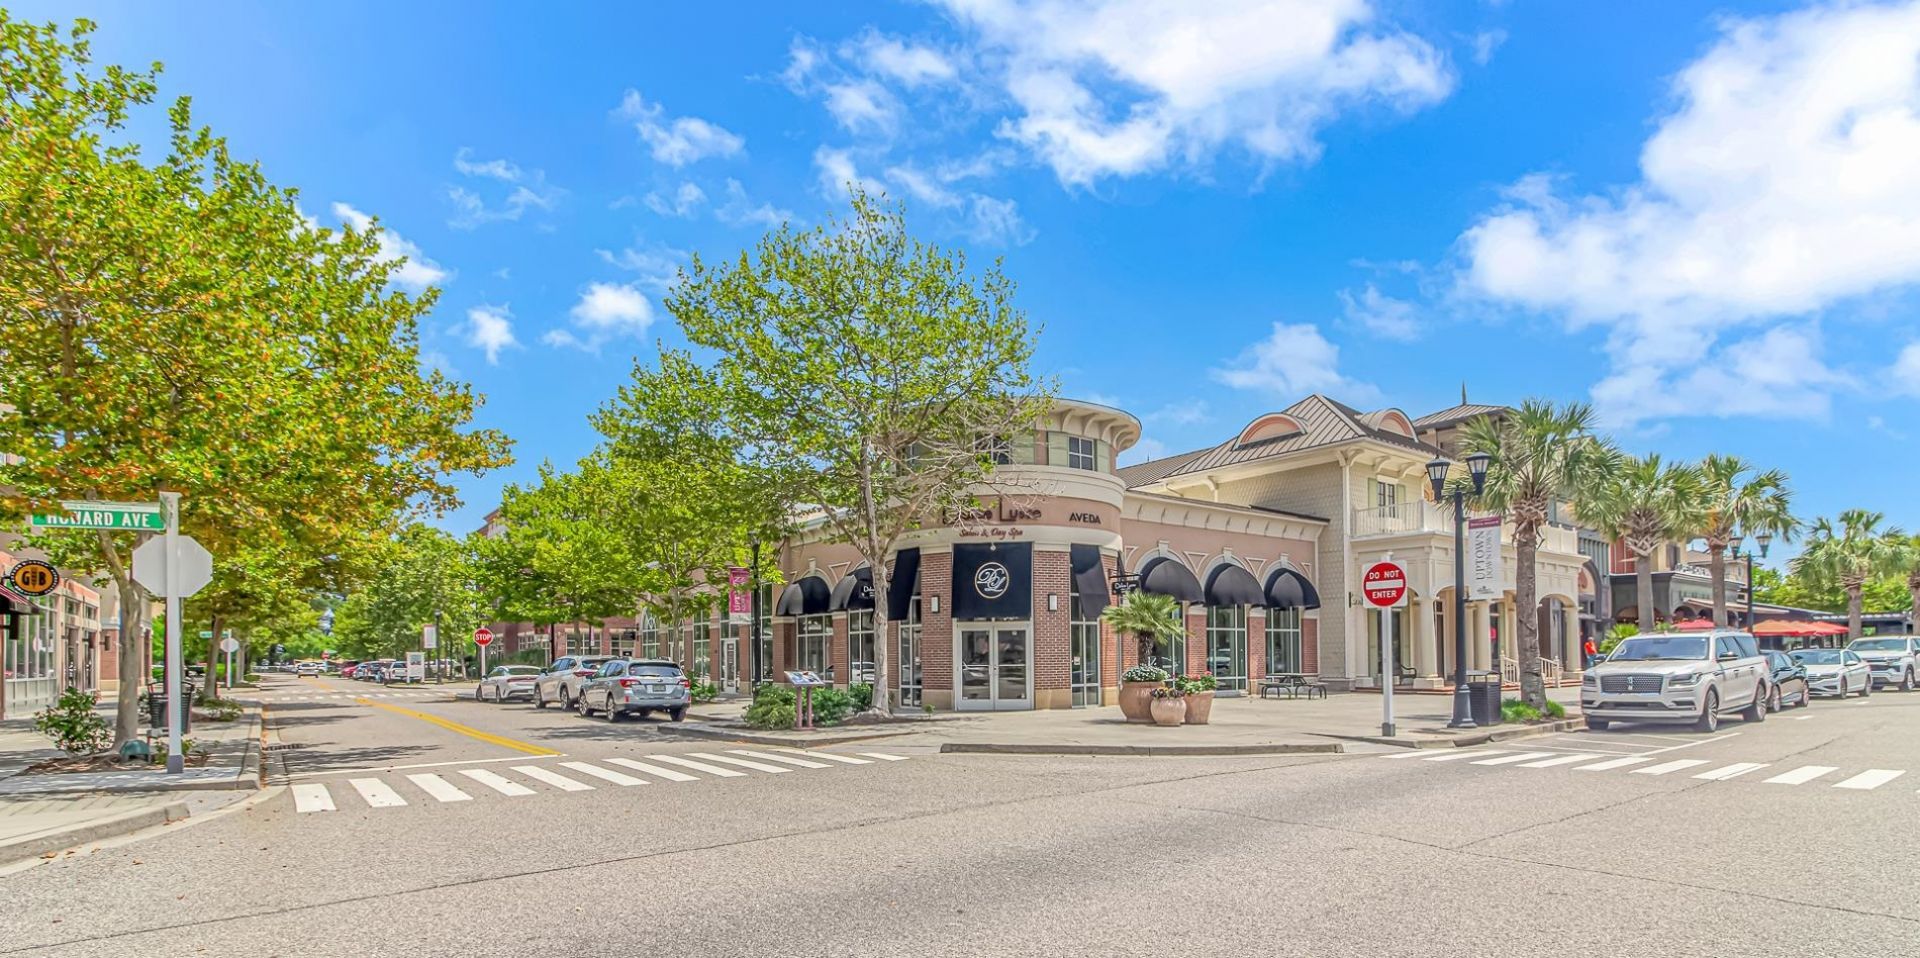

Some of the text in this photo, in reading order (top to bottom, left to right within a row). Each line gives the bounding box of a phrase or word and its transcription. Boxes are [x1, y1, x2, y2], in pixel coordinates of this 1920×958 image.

[122, 512, 150, 527] AVE
[1069, 511, 1101, 525] AVEDA
[991, 527, 1006, 540] Day
[1008, 527, 1023, 540] Spa
[1475, 530, 1485, 580] UPTOWN
[1369, 569, 1400, 580] DO NOT
[1371, 590, 1397, 599] ENTER
[475, 633, 492, 641] STOP
